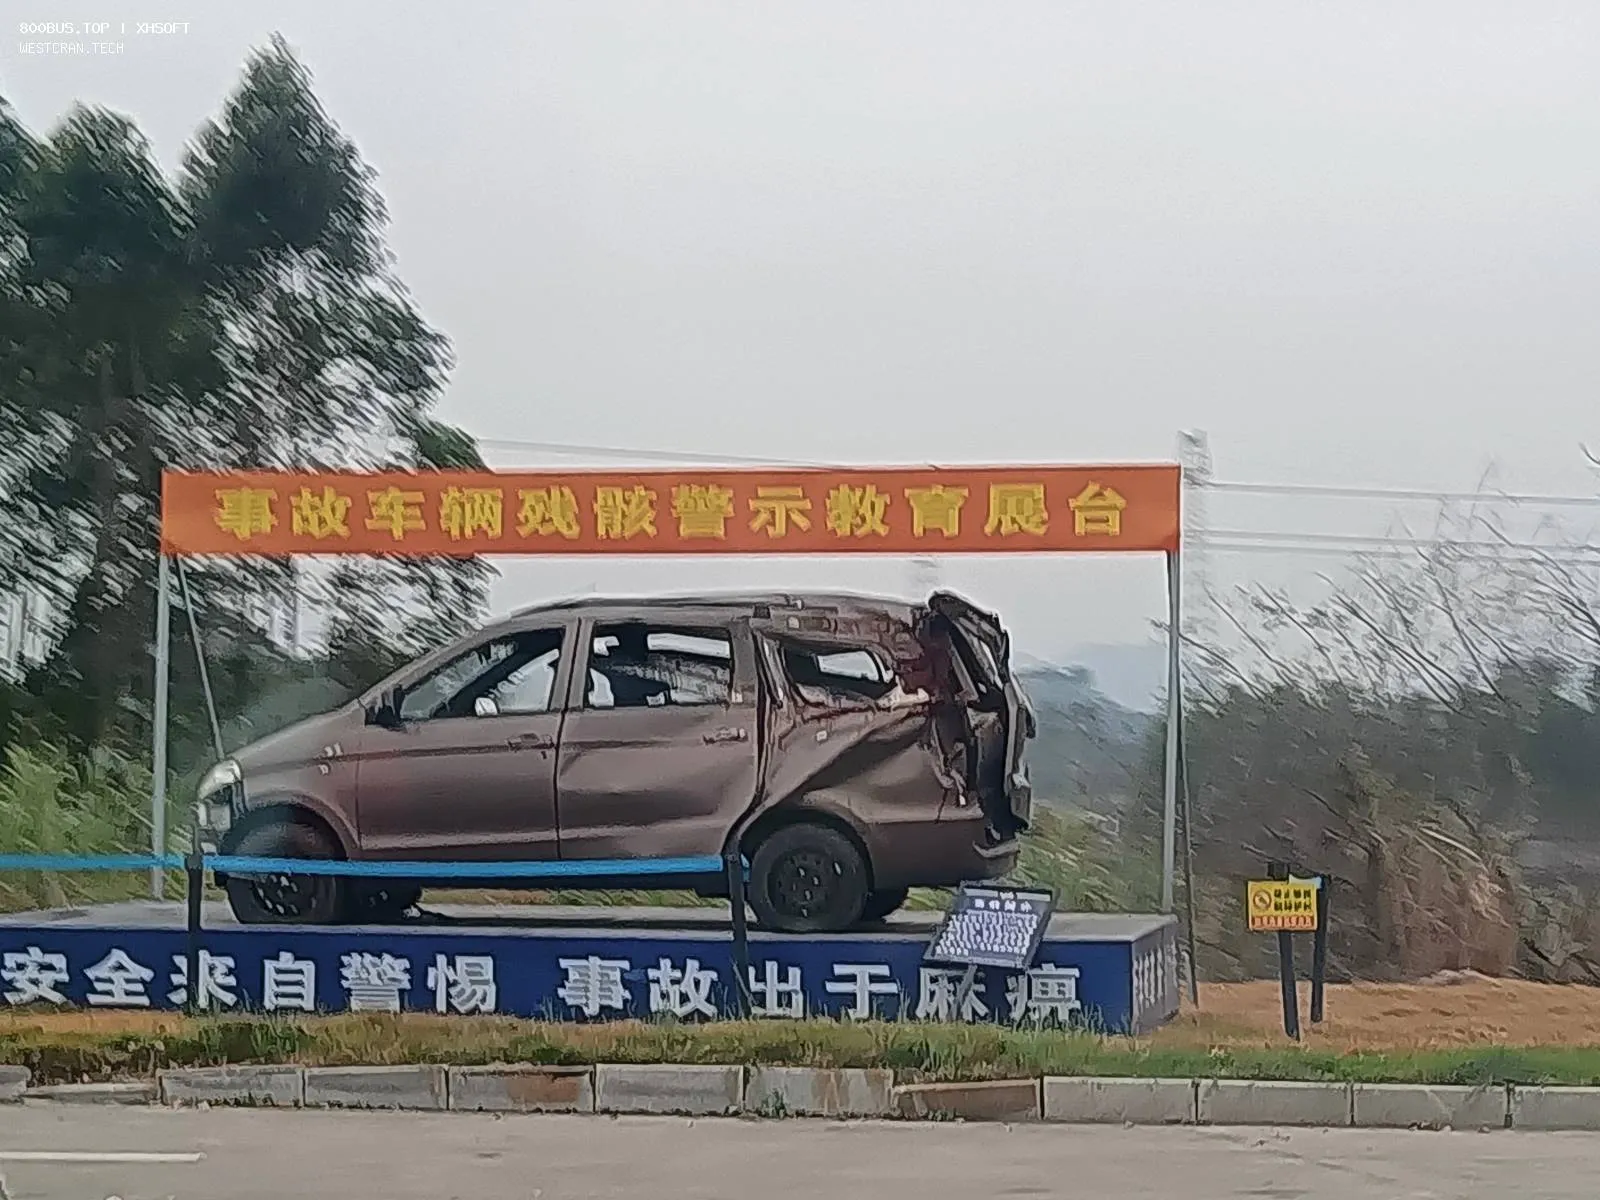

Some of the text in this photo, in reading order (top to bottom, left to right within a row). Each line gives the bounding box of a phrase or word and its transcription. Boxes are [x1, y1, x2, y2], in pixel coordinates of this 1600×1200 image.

[213, 481, 1128, 541] 事故车辆残骸警示教育展台
[1, 945, 499, 1014] 安全来自警惕
